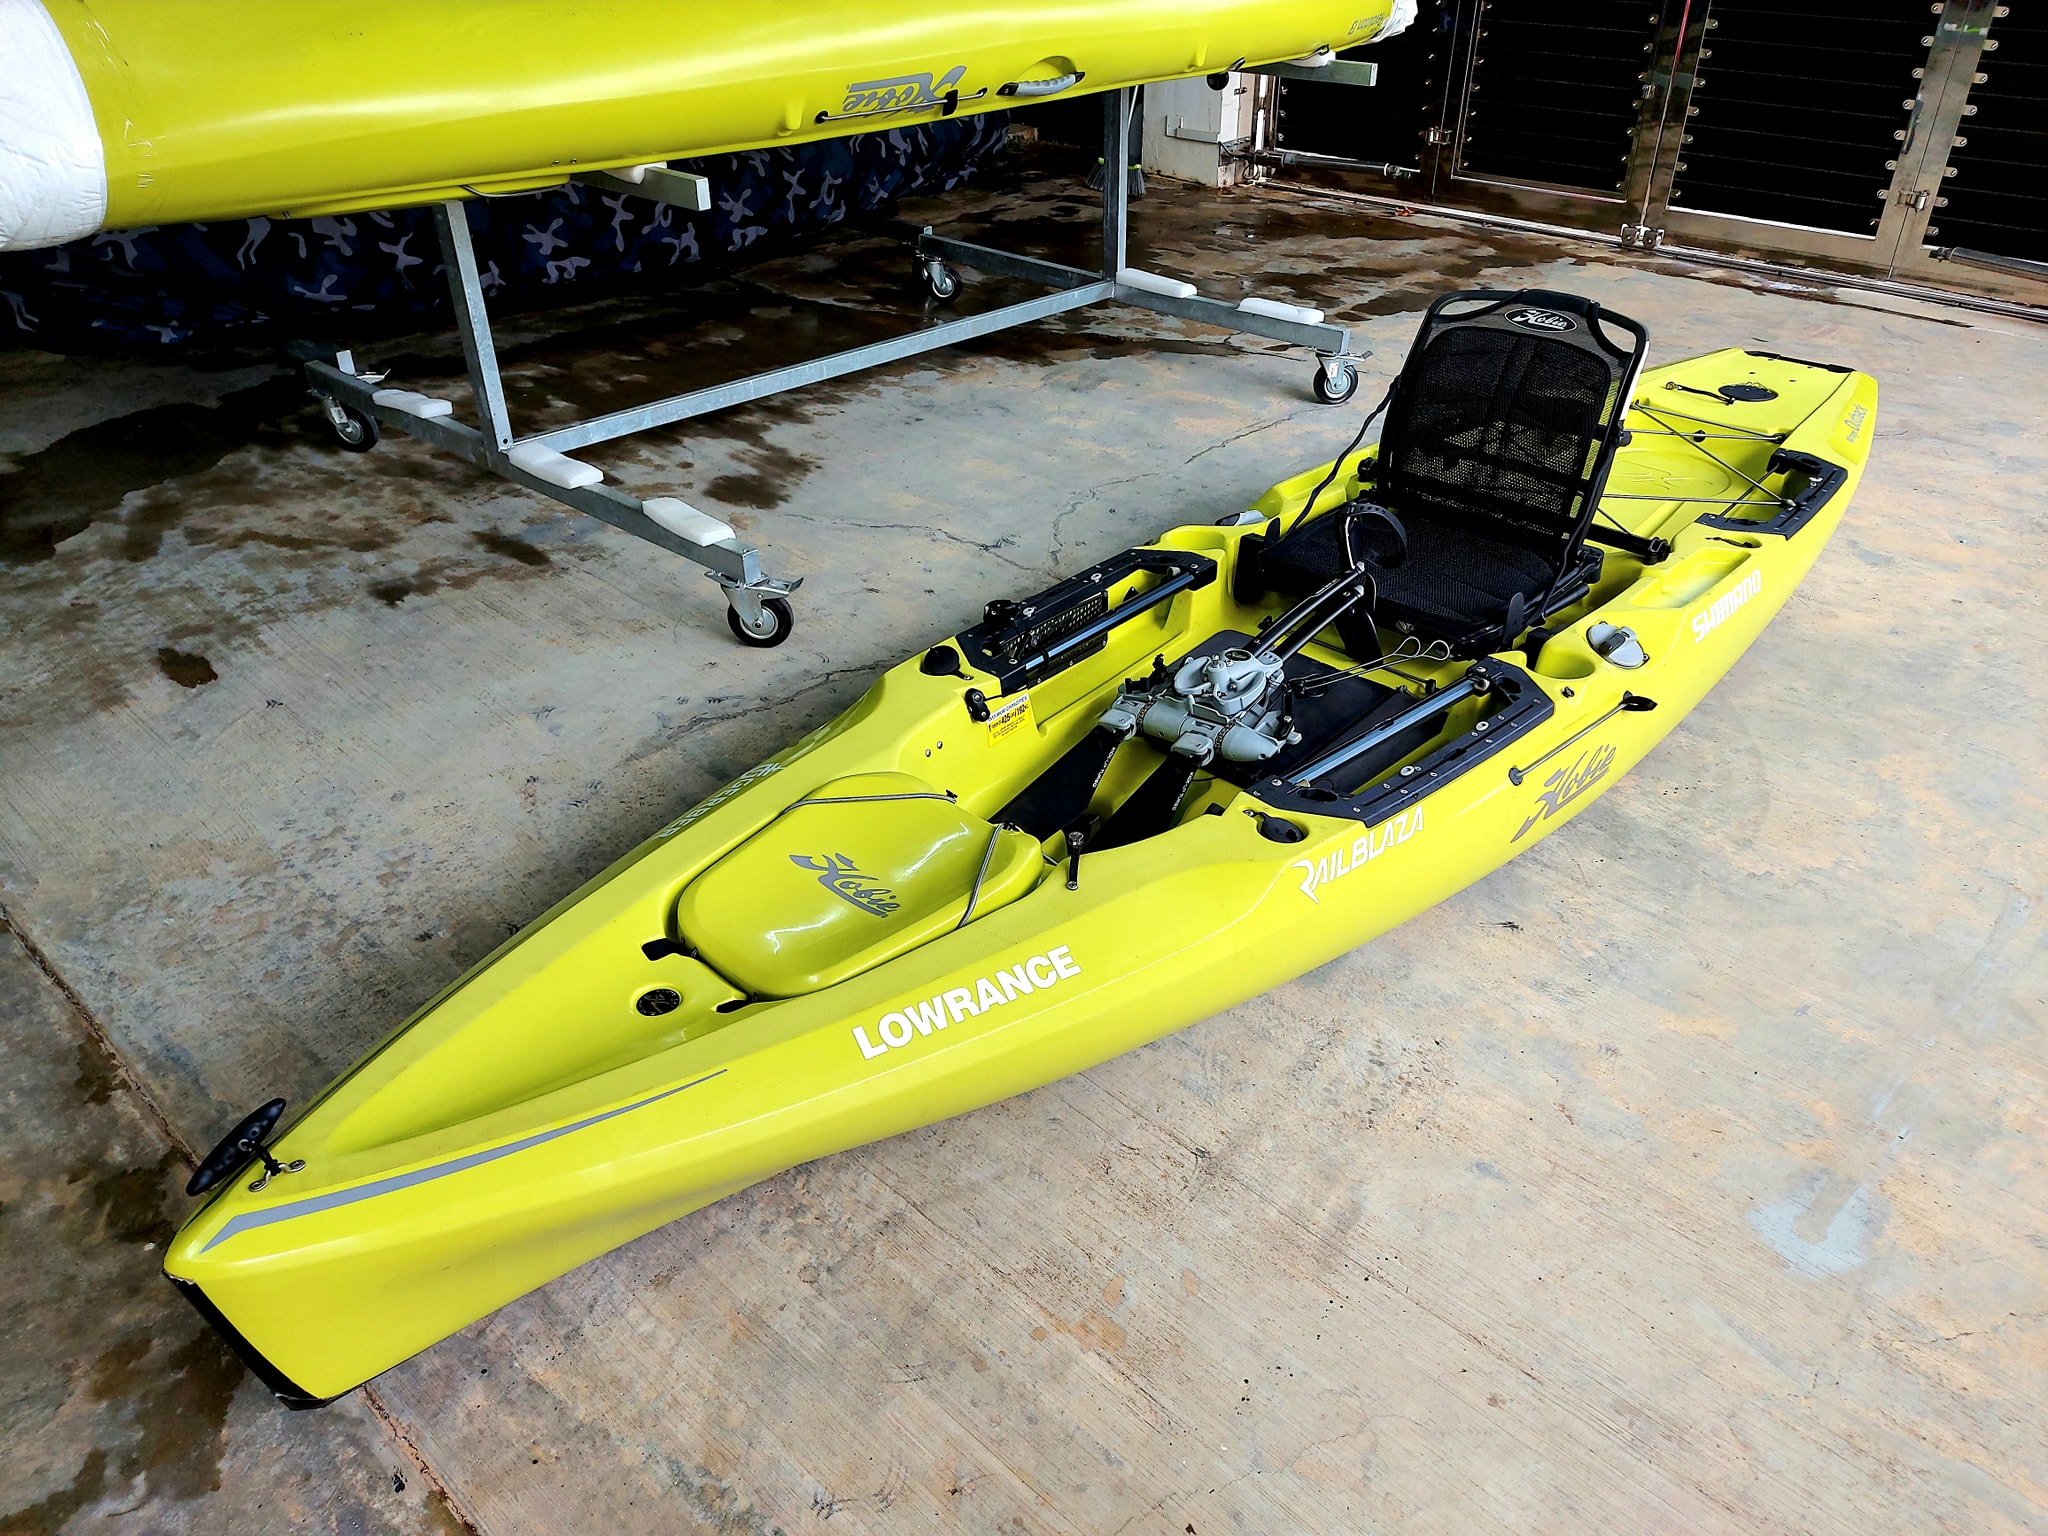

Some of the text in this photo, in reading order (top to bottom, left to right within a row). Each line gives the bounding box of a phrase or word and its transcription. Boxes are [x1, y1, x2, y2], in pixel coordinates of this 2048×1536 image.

[1511, 309, 1568, 330] Hobie
[1691, 568, 1762, 644] SHIMANO
[1511, 744, 1617, 843] Hobie
[789, 853, 900, 918] Hobie
[1290, 806, 1424, 904] RAILBLAZA
[852, 944, 1081, 1060] LOWRANCE
